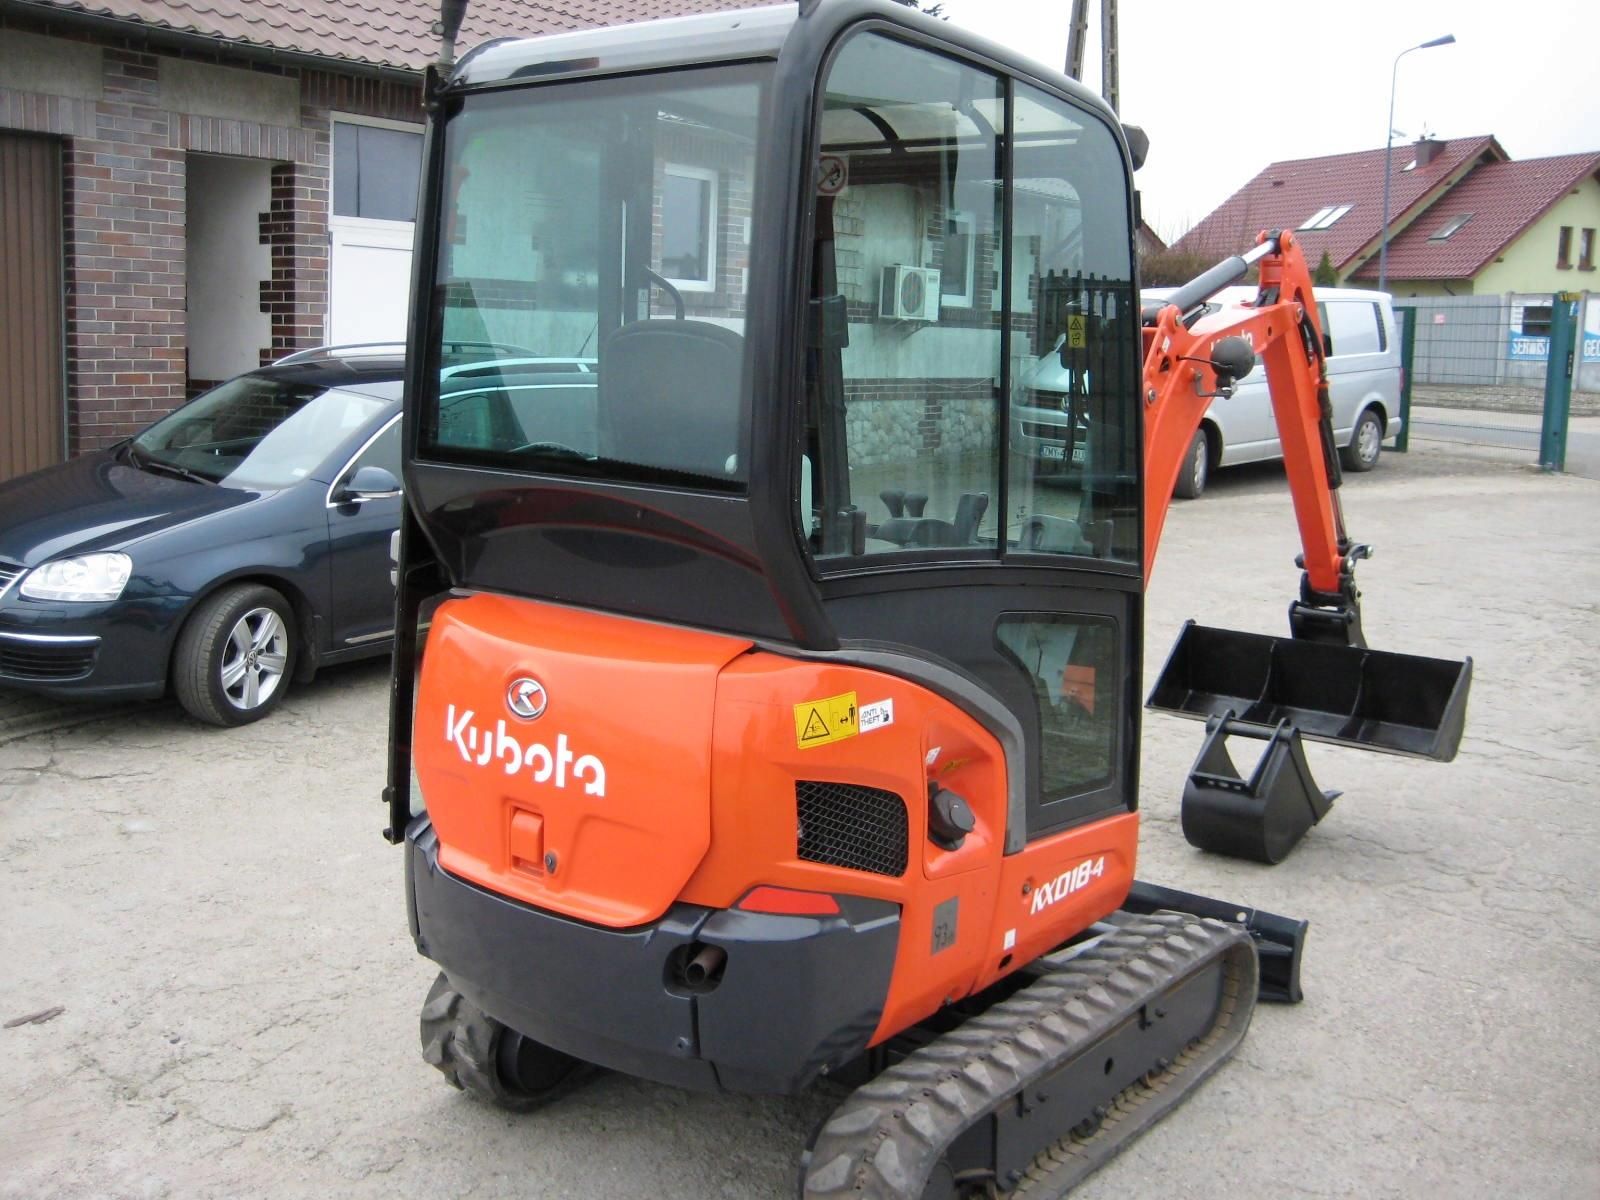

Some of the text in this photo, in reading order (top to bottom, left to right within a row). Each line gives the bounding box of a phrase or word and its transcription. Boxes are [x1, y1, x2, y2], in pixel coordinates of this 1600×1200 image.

[861, 707, 878, 719] ANTI
[861, 714, 880, 727] THEFT
[446, 703, 606, 797] Kubota
[1030, 855, 1105, 915] KX018-4
